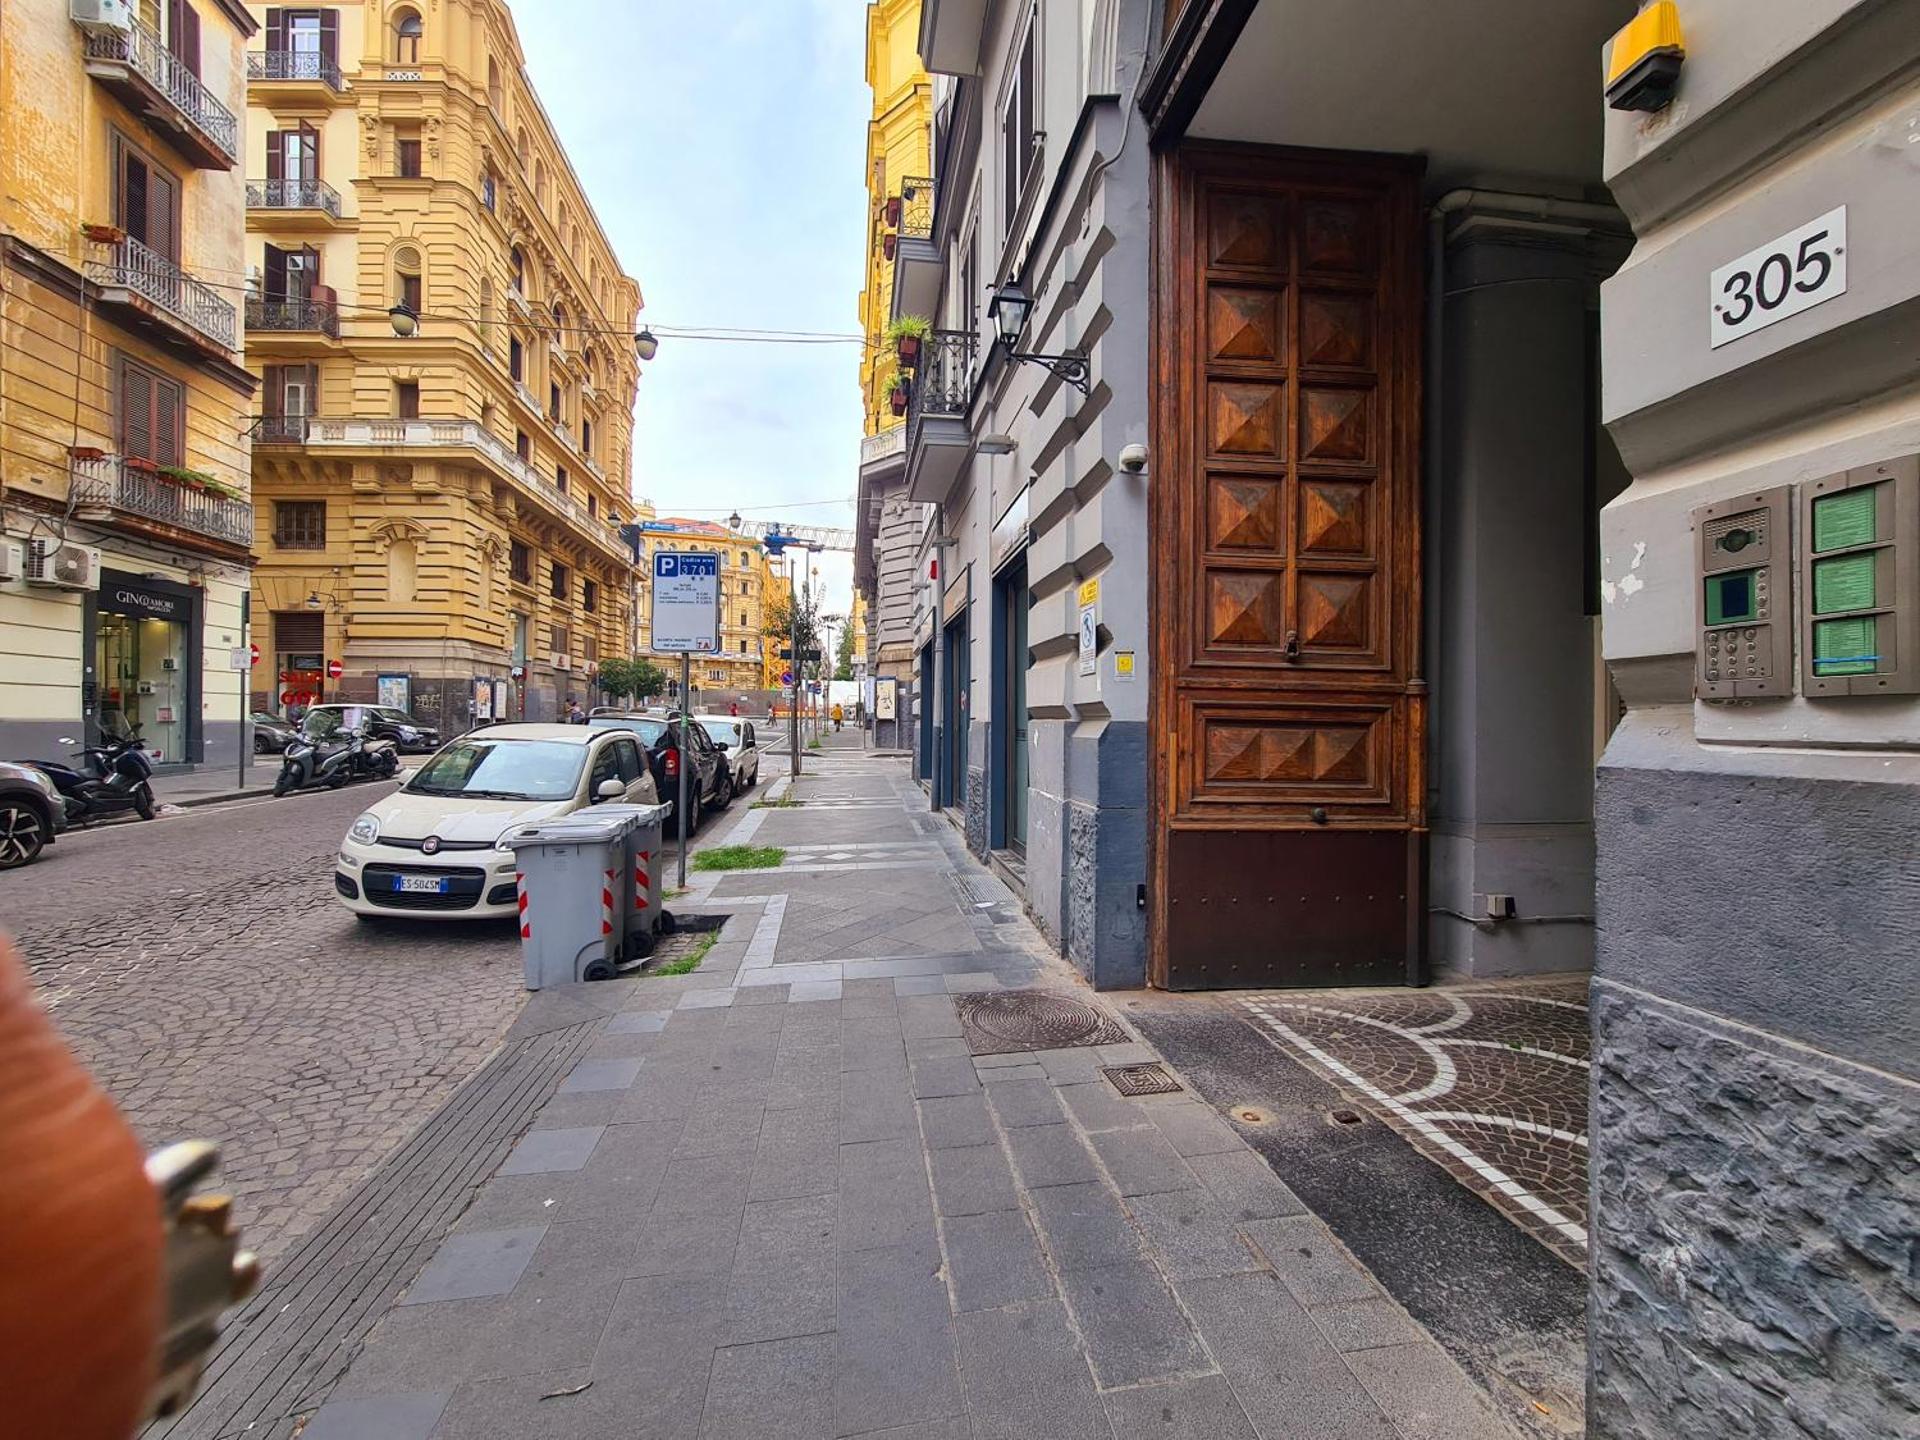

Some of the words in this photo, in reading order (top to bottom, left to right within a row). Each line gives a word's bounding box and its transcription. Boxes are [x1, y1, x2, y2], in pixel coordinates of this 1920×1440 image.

[1722, 229, 1831, 326] 305
[661, 557, 674, 574] P
[681, 565, 713, 576] 3701
